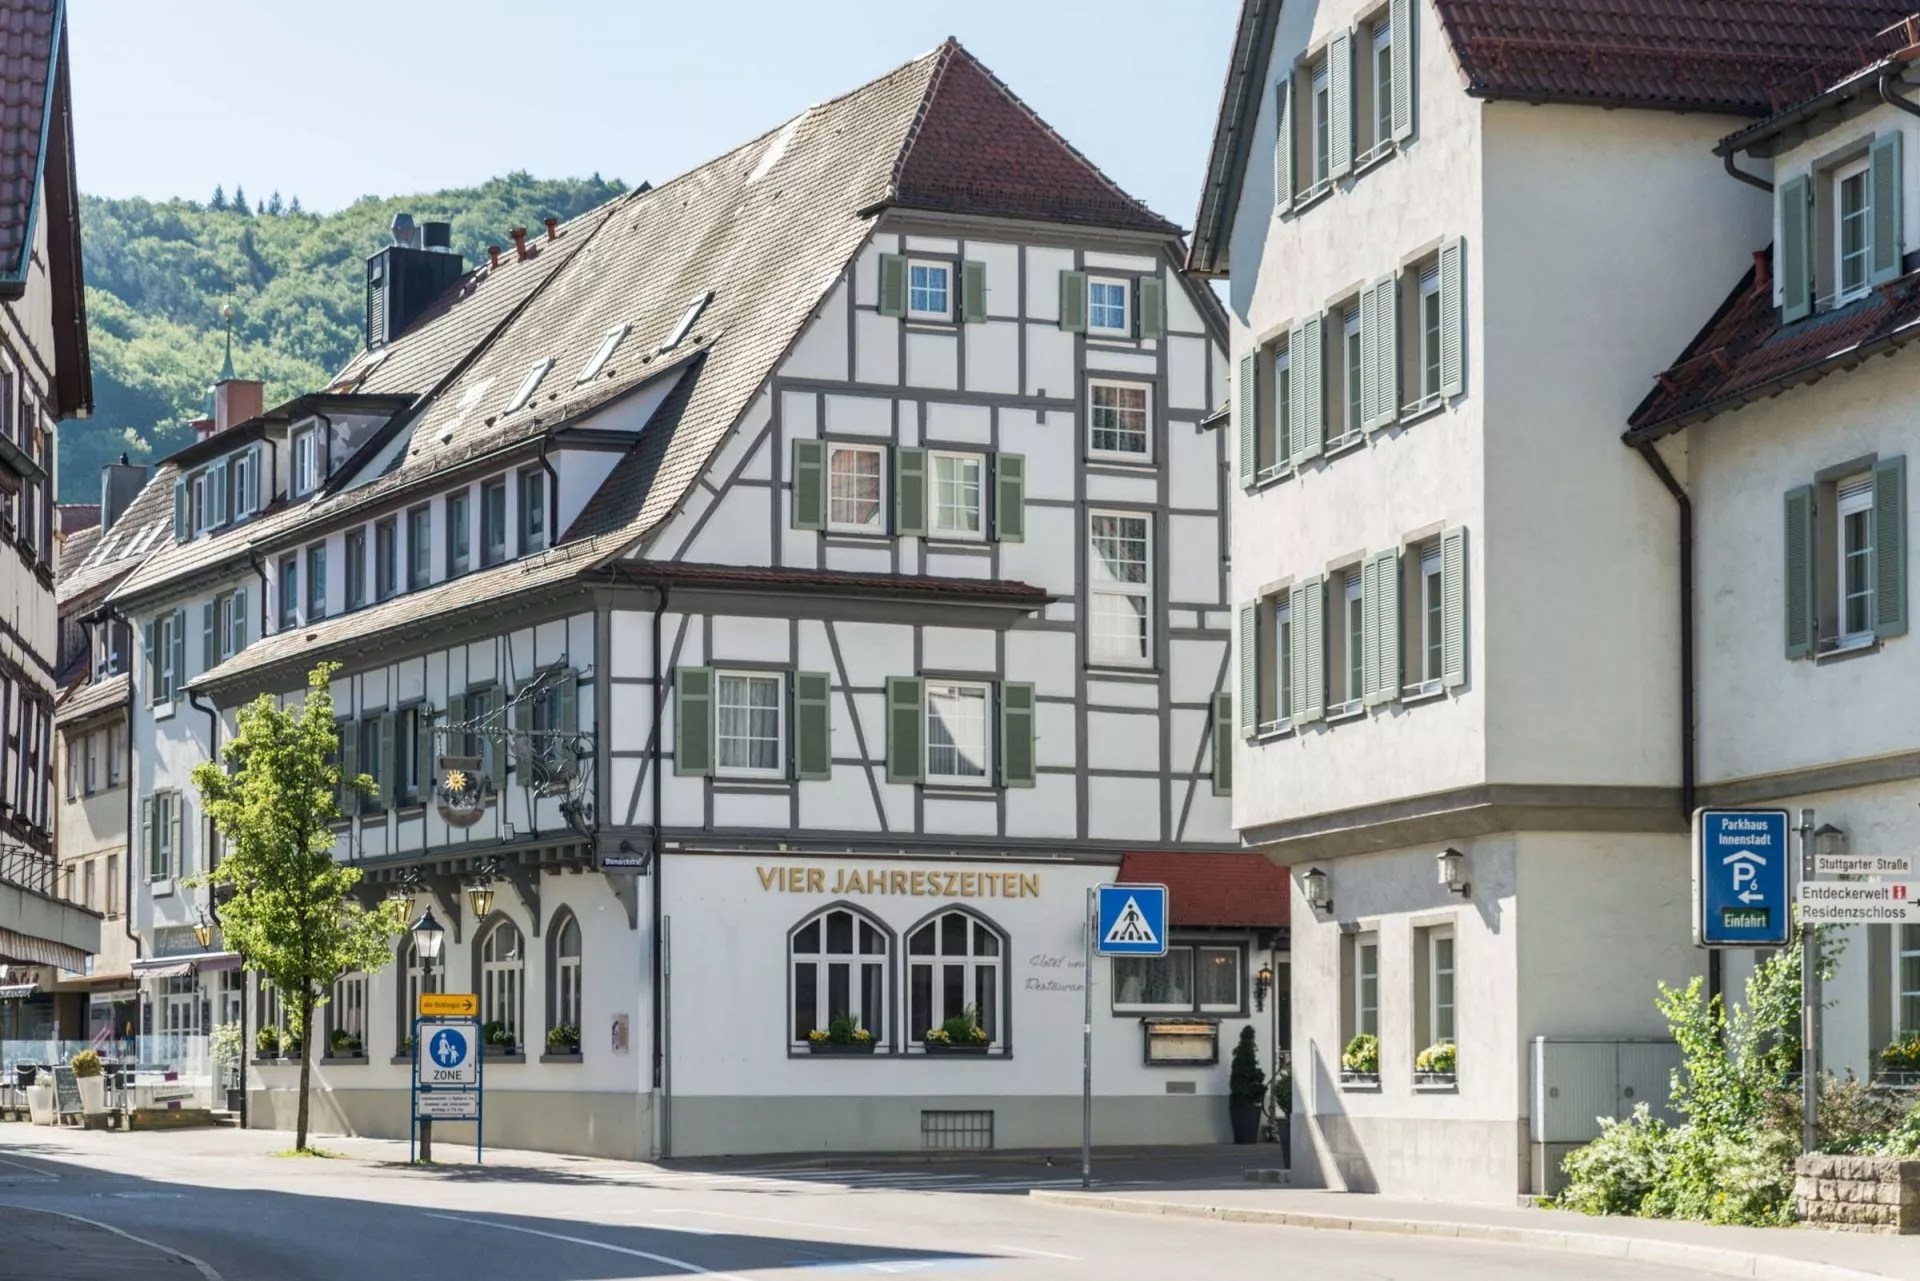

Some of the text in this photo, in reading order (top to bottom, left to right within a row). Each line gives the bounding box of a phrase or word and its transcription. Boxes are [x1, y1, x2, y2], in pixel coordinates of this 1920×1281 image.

[1722, 817, 1768, 830] Parkhaus
[1719, 832, 1771, 845] Innenstadt
[1819, 857, 1908, 872] Stuttgarter Straße
[756, 866, 1040, 898] VIER JAHRESZEITEN
[1802, 886, 1889, 899] Entdeckerwelt
[1802, 905, 1906, 918] Residenzschloss
[1724, 913, 1767, 928] Einfahrt
[1029, 954, 1065, 967] Hotel
[433, 1070, 462, 1080] ZONE
